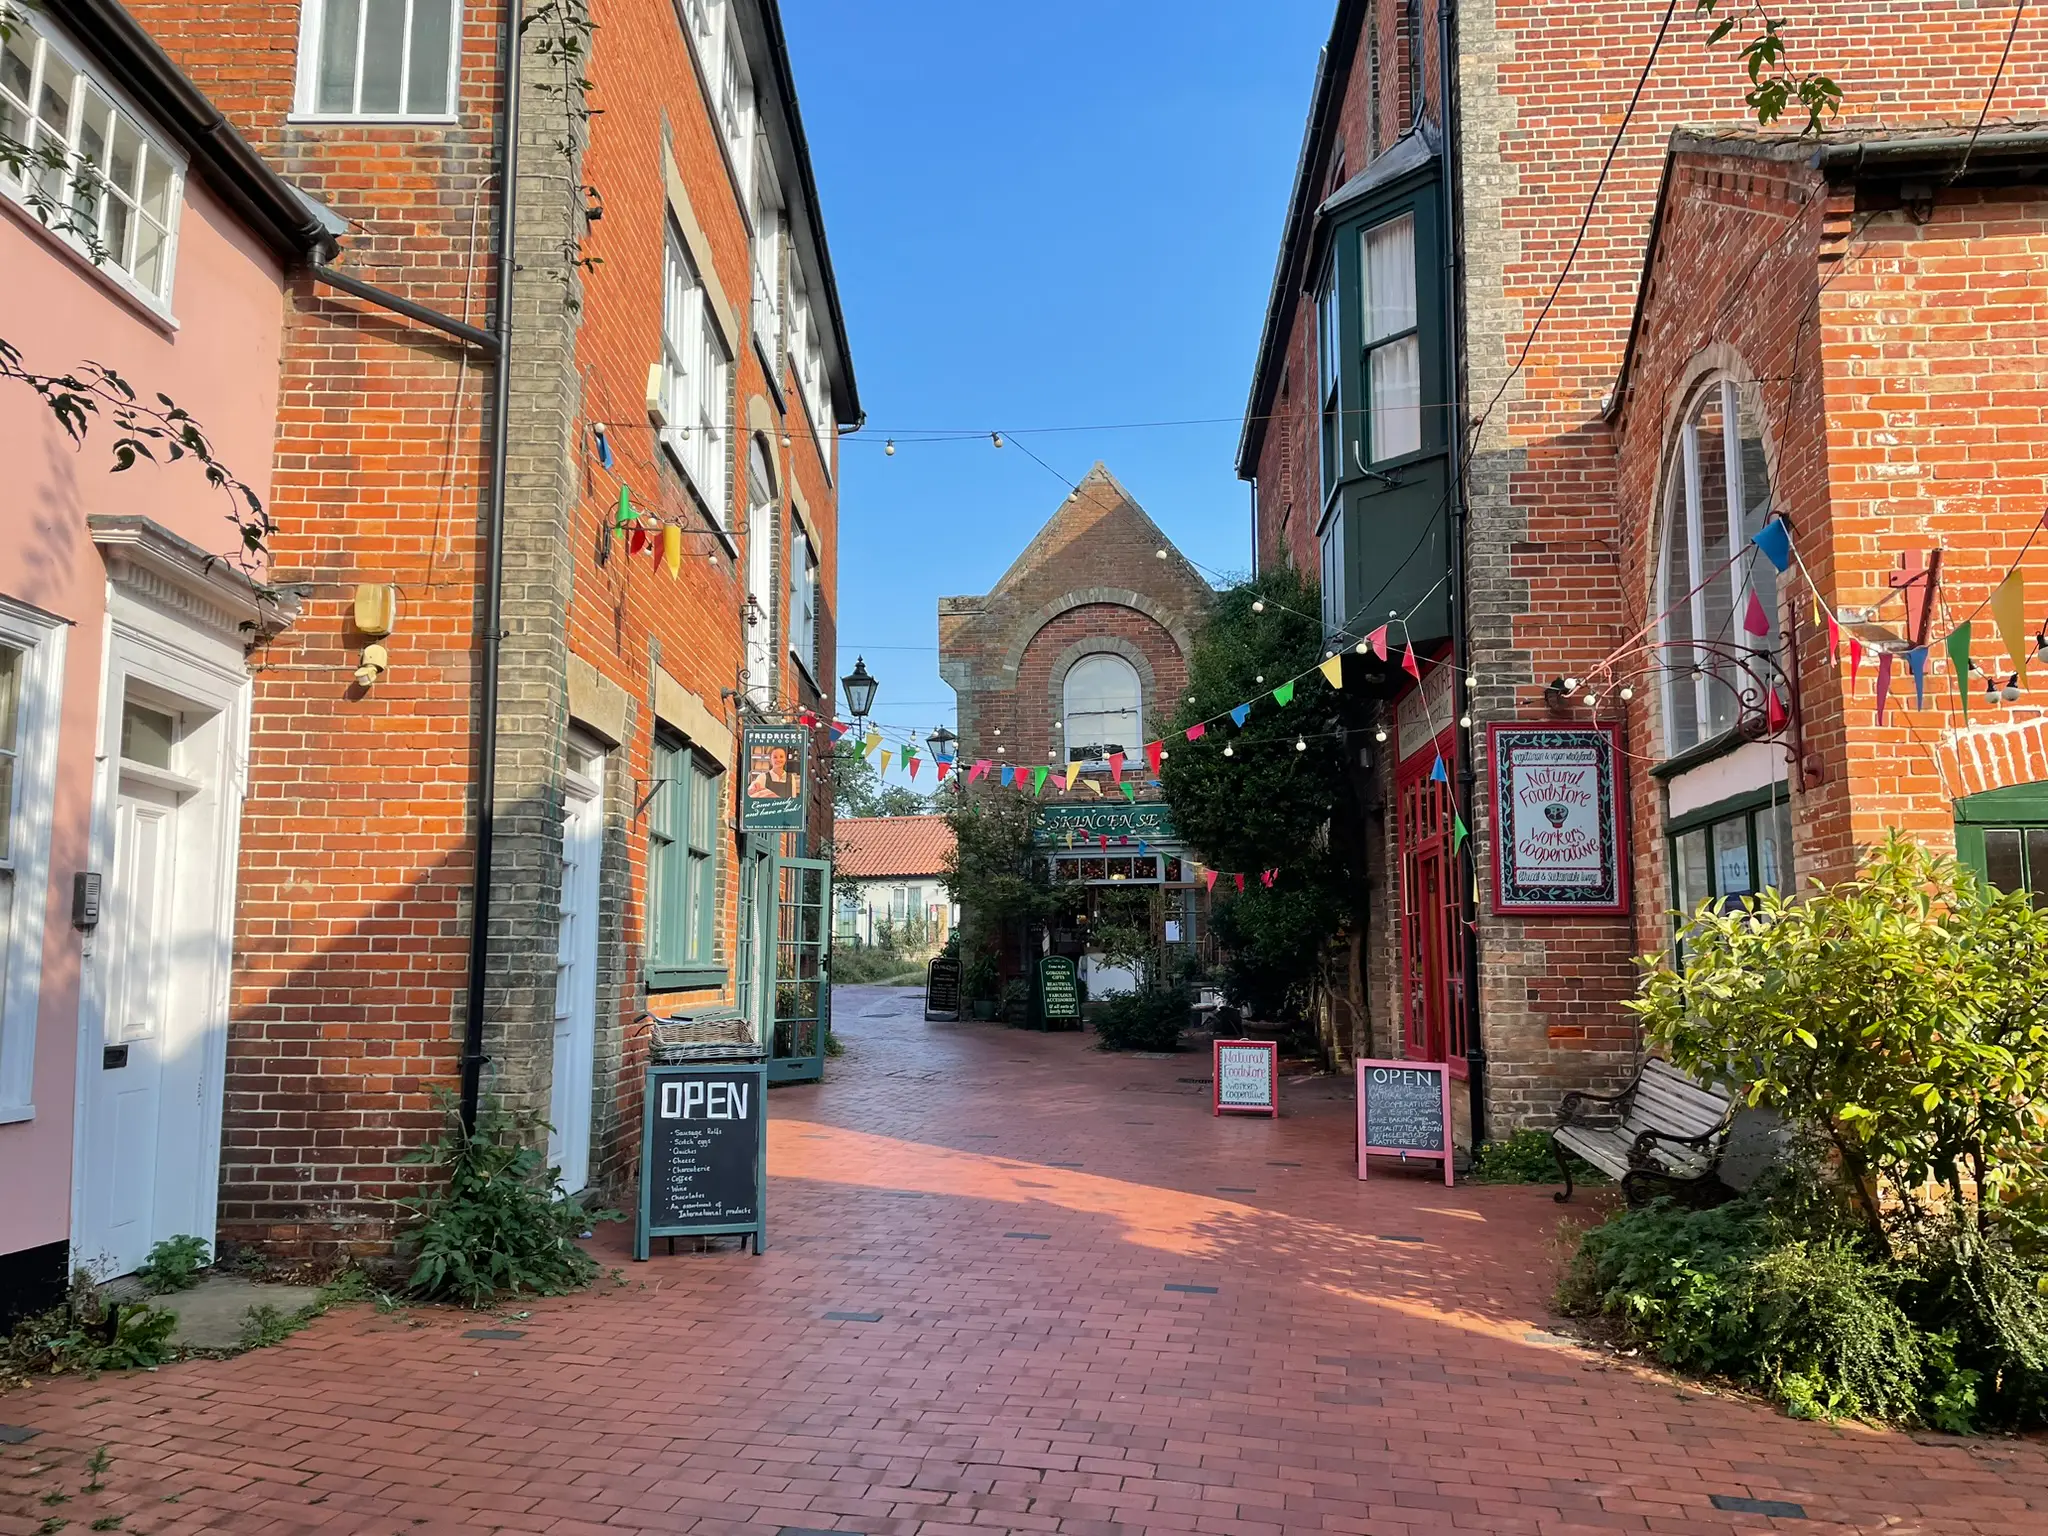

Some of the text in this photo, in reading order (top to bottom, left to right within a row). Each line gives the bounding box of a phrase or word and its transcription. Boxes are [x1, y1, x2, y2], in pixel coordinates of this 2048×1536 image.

[749, 732, 803, 740] FREDRICKS
[1550, 753, 1565, 763] vegan
[1525, 766, 1586, 788] Natural
[1519, 783, 1592, 808] Foodstore
[751, 801, 771, 810] Come
[745, 809, 760, 818] and
[760, 808, 777, 816] have
[1518, 837, 1600, 866] Cooperative
[1223, 1050, 1265, 1065] Natural
[1223, 1064, 1267, 1080] Foodstore
[1373, 1068, 1432, 1086] OPEN
[661, 1081, 749, 1119] OPEN
[1379, 1100, 1431, 1108] COOPERATIVE
[674, 1127, 723, 1138] Sausage Rolls
[674, 1138, 712, 1147] Scotch eggs
[672, 1147, 697, 1155] Quiches
[672, 1165, 711, 1174] Charcuterie
[671, 1175, 693, 1184] Coffee
[670, 1193, 705, 1201] Chocolates
[682, 1201, 712, 1209] assortment
[715, 1201, 722, 1209] of
[678, 1206, 751, 1219] International products
